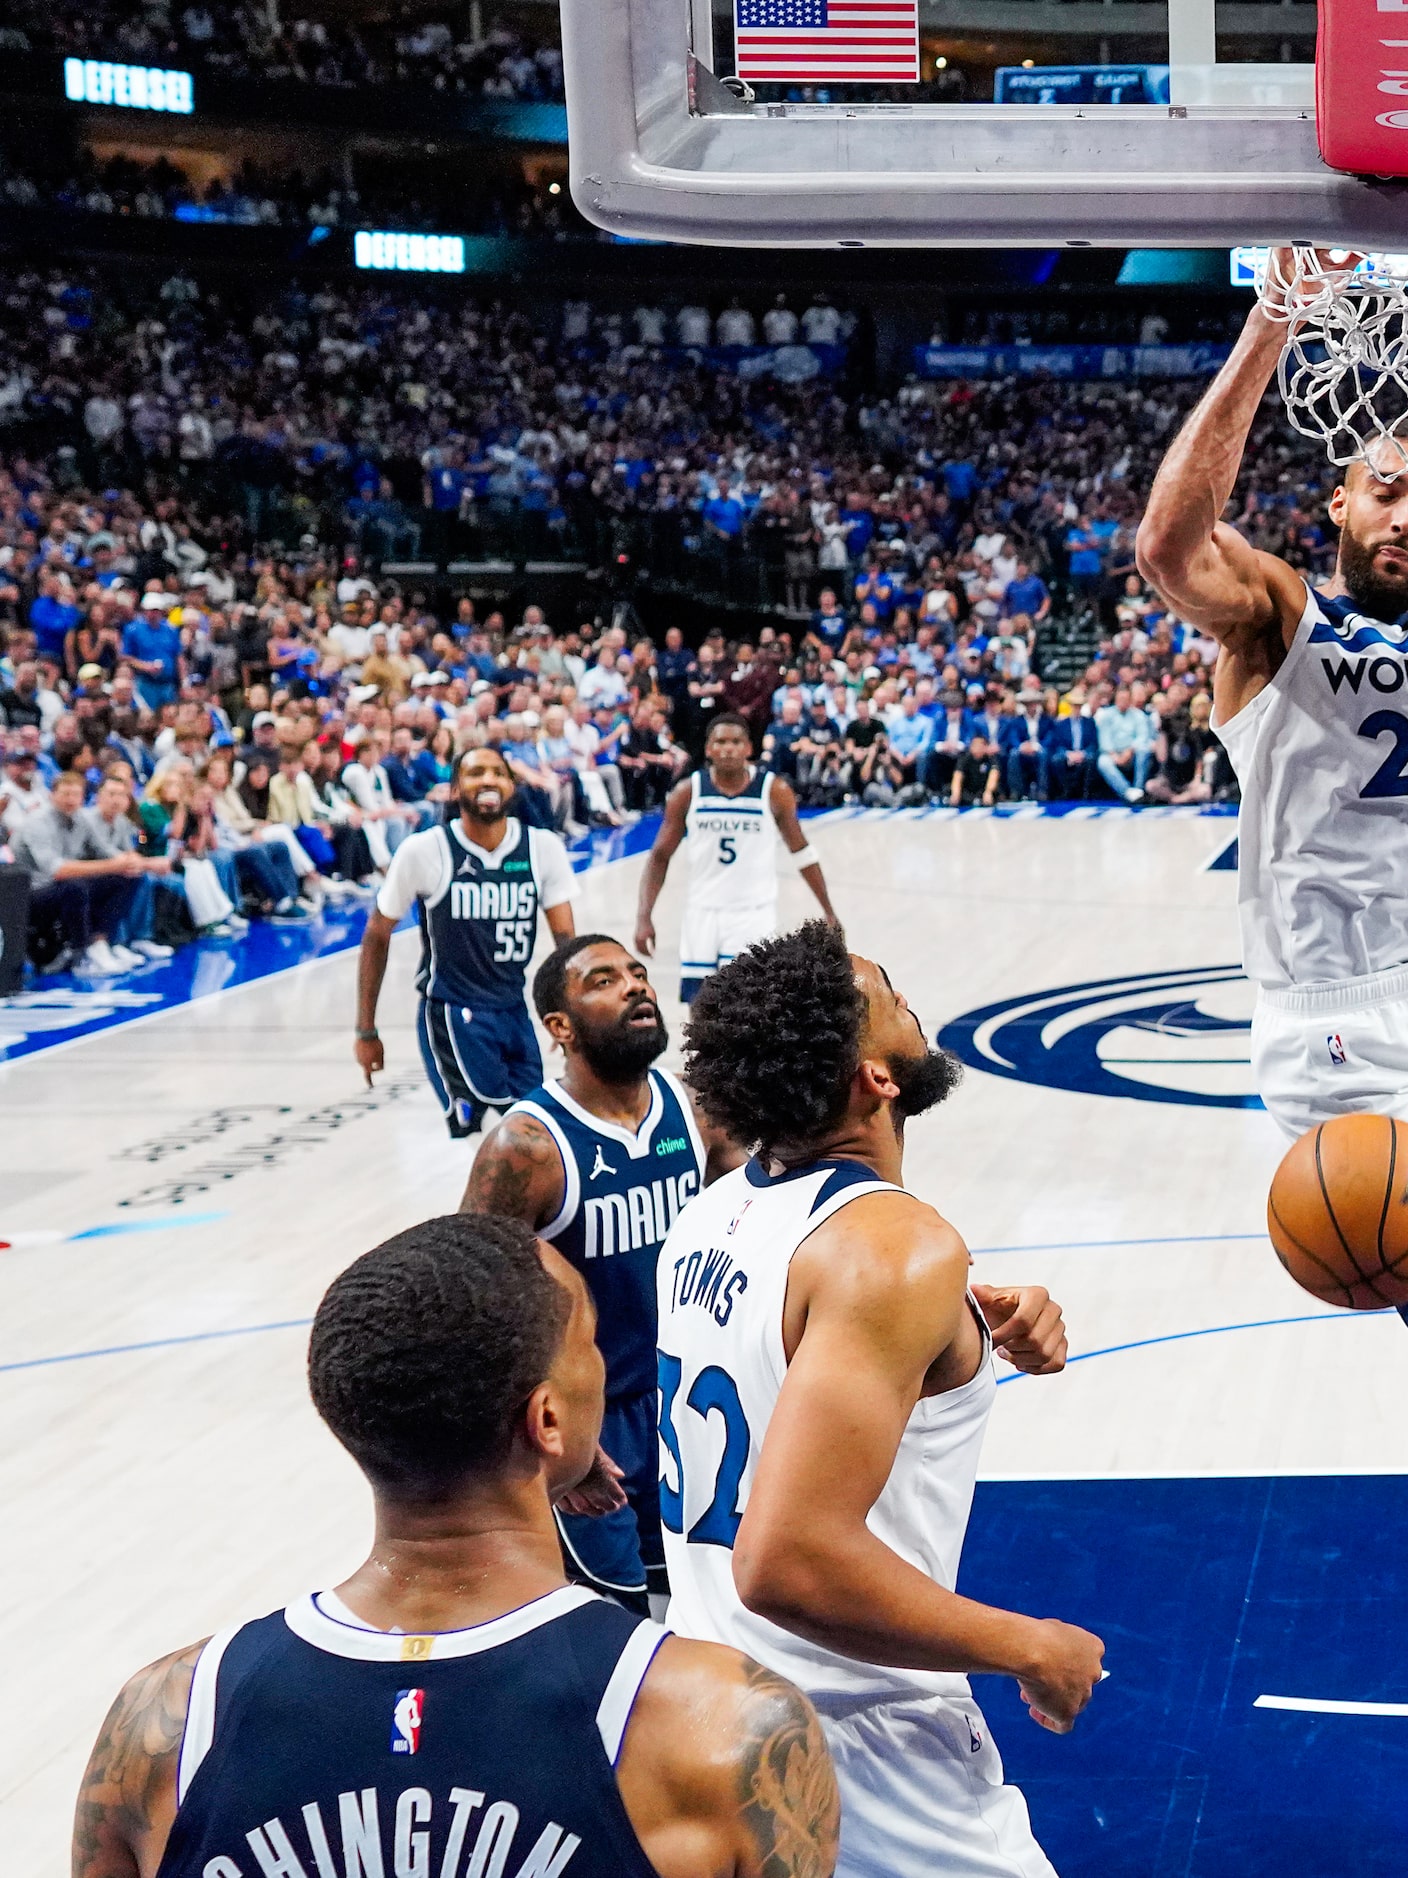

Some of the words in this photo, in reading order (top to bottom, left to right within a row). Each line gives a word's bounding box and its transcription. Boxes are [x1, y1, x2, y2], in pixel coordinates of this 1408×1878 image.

[696, 818, 762, 833] WOLVES
[718, 837, 738, 865] 5
[450, 881, 536, 920] MAVS
[493, 920, 533, 962] 55
[656, 1136, 687, 1157] chime
[672, 1248, 748, 1327] TOWNS
[202, 1786, 582, 1878] HINGTON
